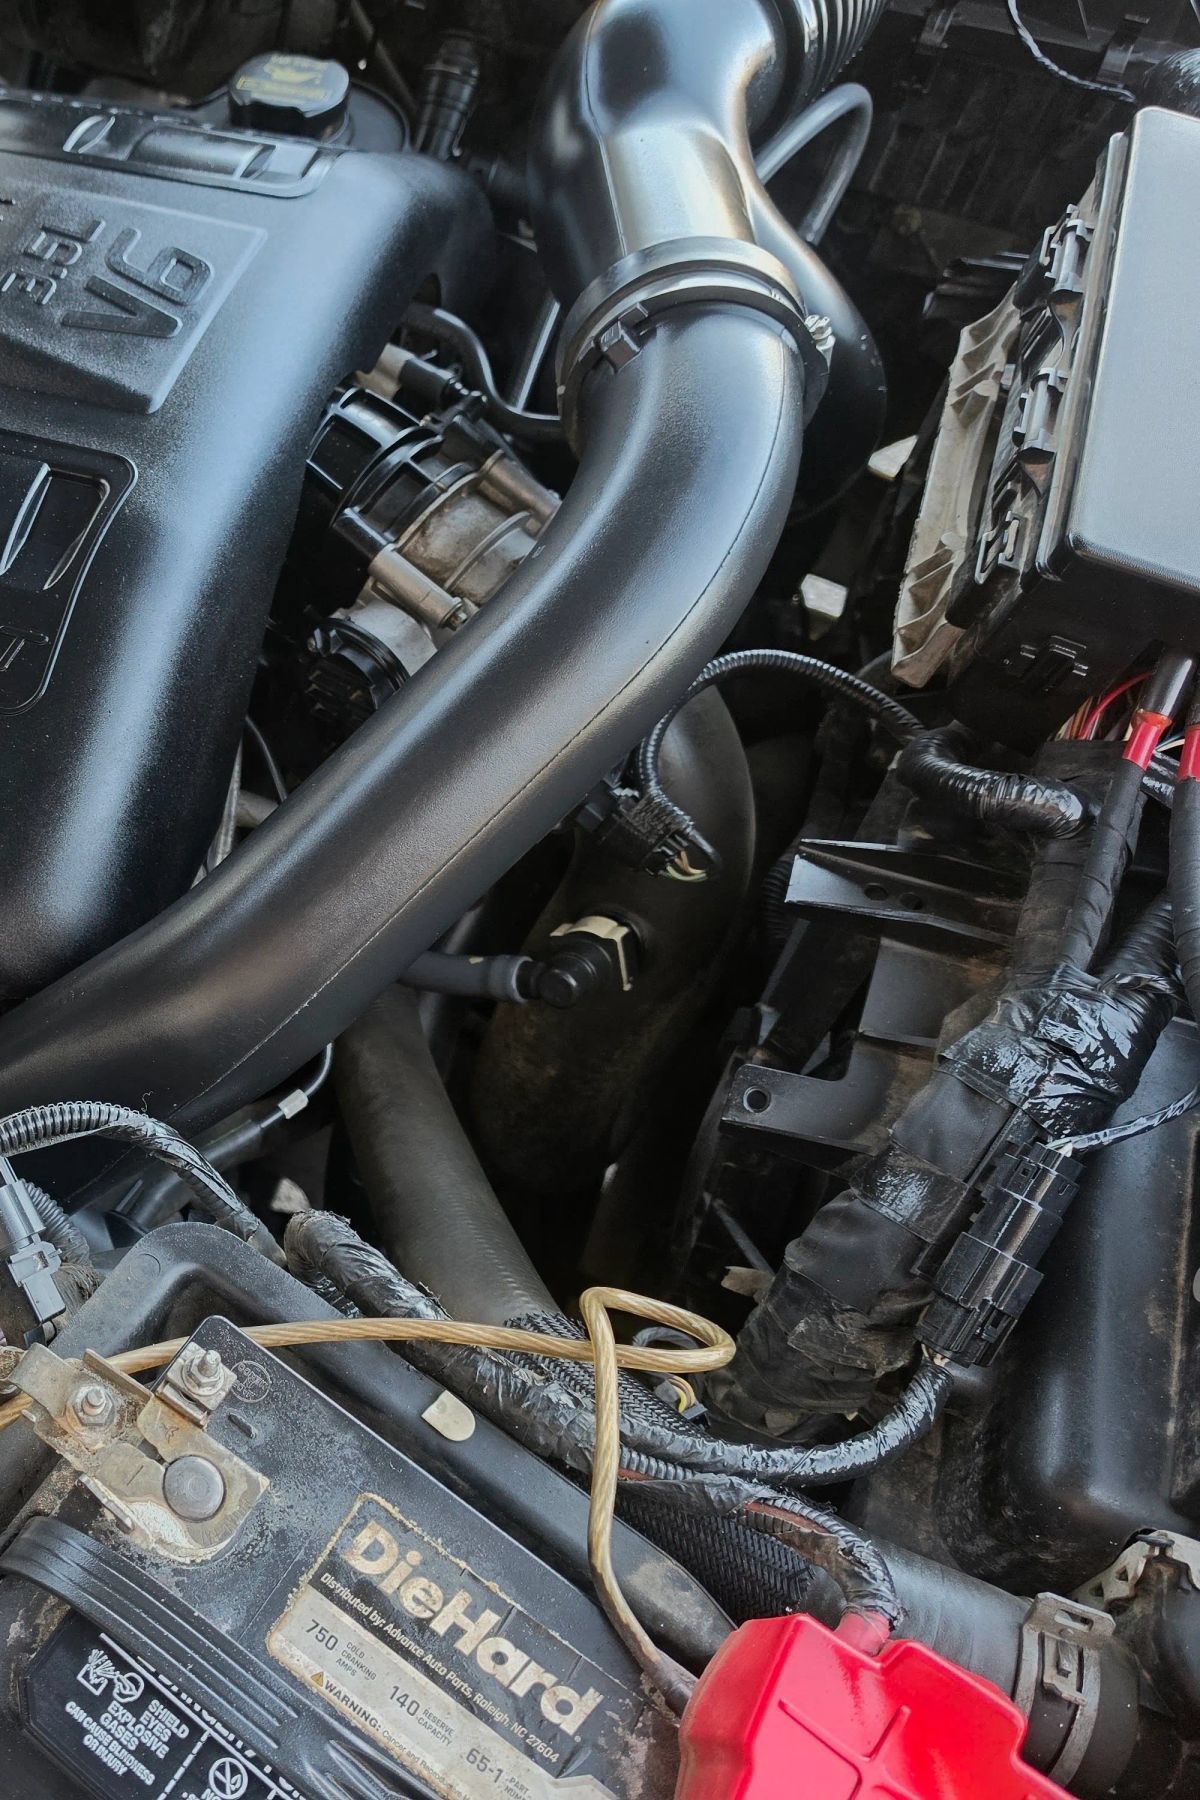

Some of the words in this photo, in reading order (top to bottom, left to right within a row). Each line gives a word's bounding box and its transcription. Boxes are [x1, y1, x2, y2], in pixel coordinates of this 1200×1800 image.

[61, 228, 215, 339] V6
[305, 1618, 339, 1651] 750
[341, 1520, 603, 1738] DieHard
[320, 1573, 374, 1620] Distributed
[369, 1608, 386, 1628] by:
[384, 1623, 426, 1657] Advance
[423, 1654, 447, 1677] Auto
[445, 1671, 473, 1699] Parts,
[473, 1693, 511, 1728] Raleigh,
[510, 1722, 528, 1739] NC
[526, 1734, 560, 1763] 27604
[336, 1658, 357, 1677] AMPS
[340, 1650, 377, 1681] CRANKING
[346, 1641, 365, 1659] COLD
[148, 1700, 190, 1739] SHIELD
[325, 1680, 382, 1732] WARNING:
[389, 1685, 420, 1717] 140
[99, 1712, 139, 1751] GASES
[107, 1700, 170, 1759] EXPLOSIVE
[140, 1710, 172, 1742] EYES
[417, 1717, 453, 1747] CAPACITY
[422, 1708, 456, 1736] RESERVE
[65, 1701, 87, 1722] CAN
[82, 1717, 113, 1746] CAUSE
[108, 1740, 156, 1786] BLINDNESS
[83, 1734, 100, 1752] OR
[95, 1744, 128, 1776] INJURY
[466, 1747, 504, 1784] 65-1
[509, 1776, 530, 1796] PART
